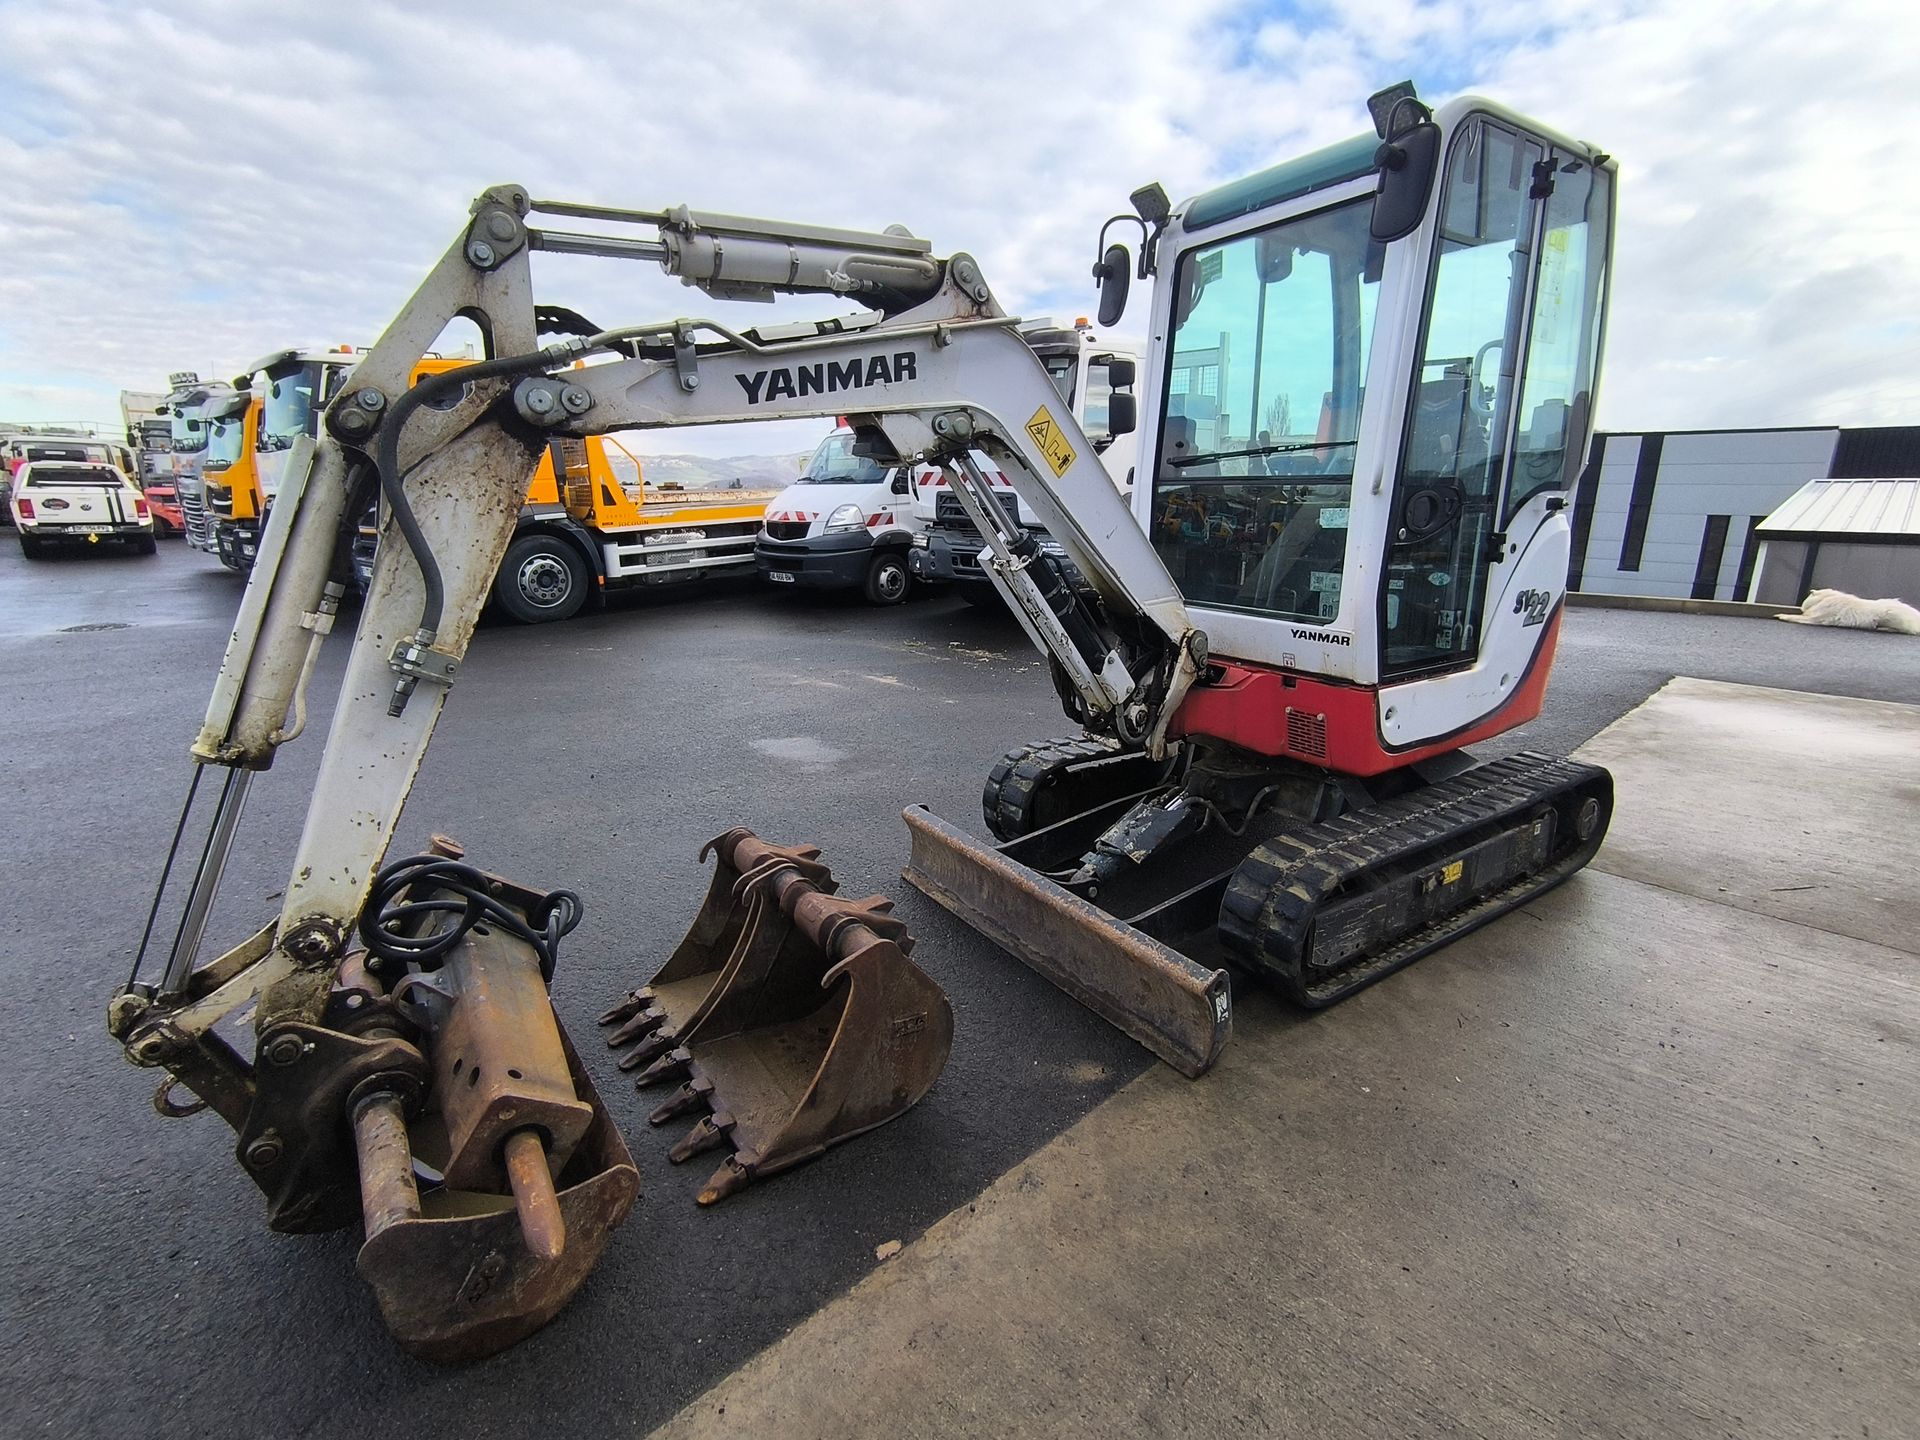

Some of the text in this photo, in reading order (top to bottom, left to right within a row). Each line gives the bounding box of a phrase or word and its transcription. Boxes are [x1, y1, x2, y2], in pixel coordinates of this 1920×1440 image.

[734, 352, 916, 404] YANMAR
[1322, 604, 1333, 617] 80
[1290, 628, 1351, 647] YANMAR
